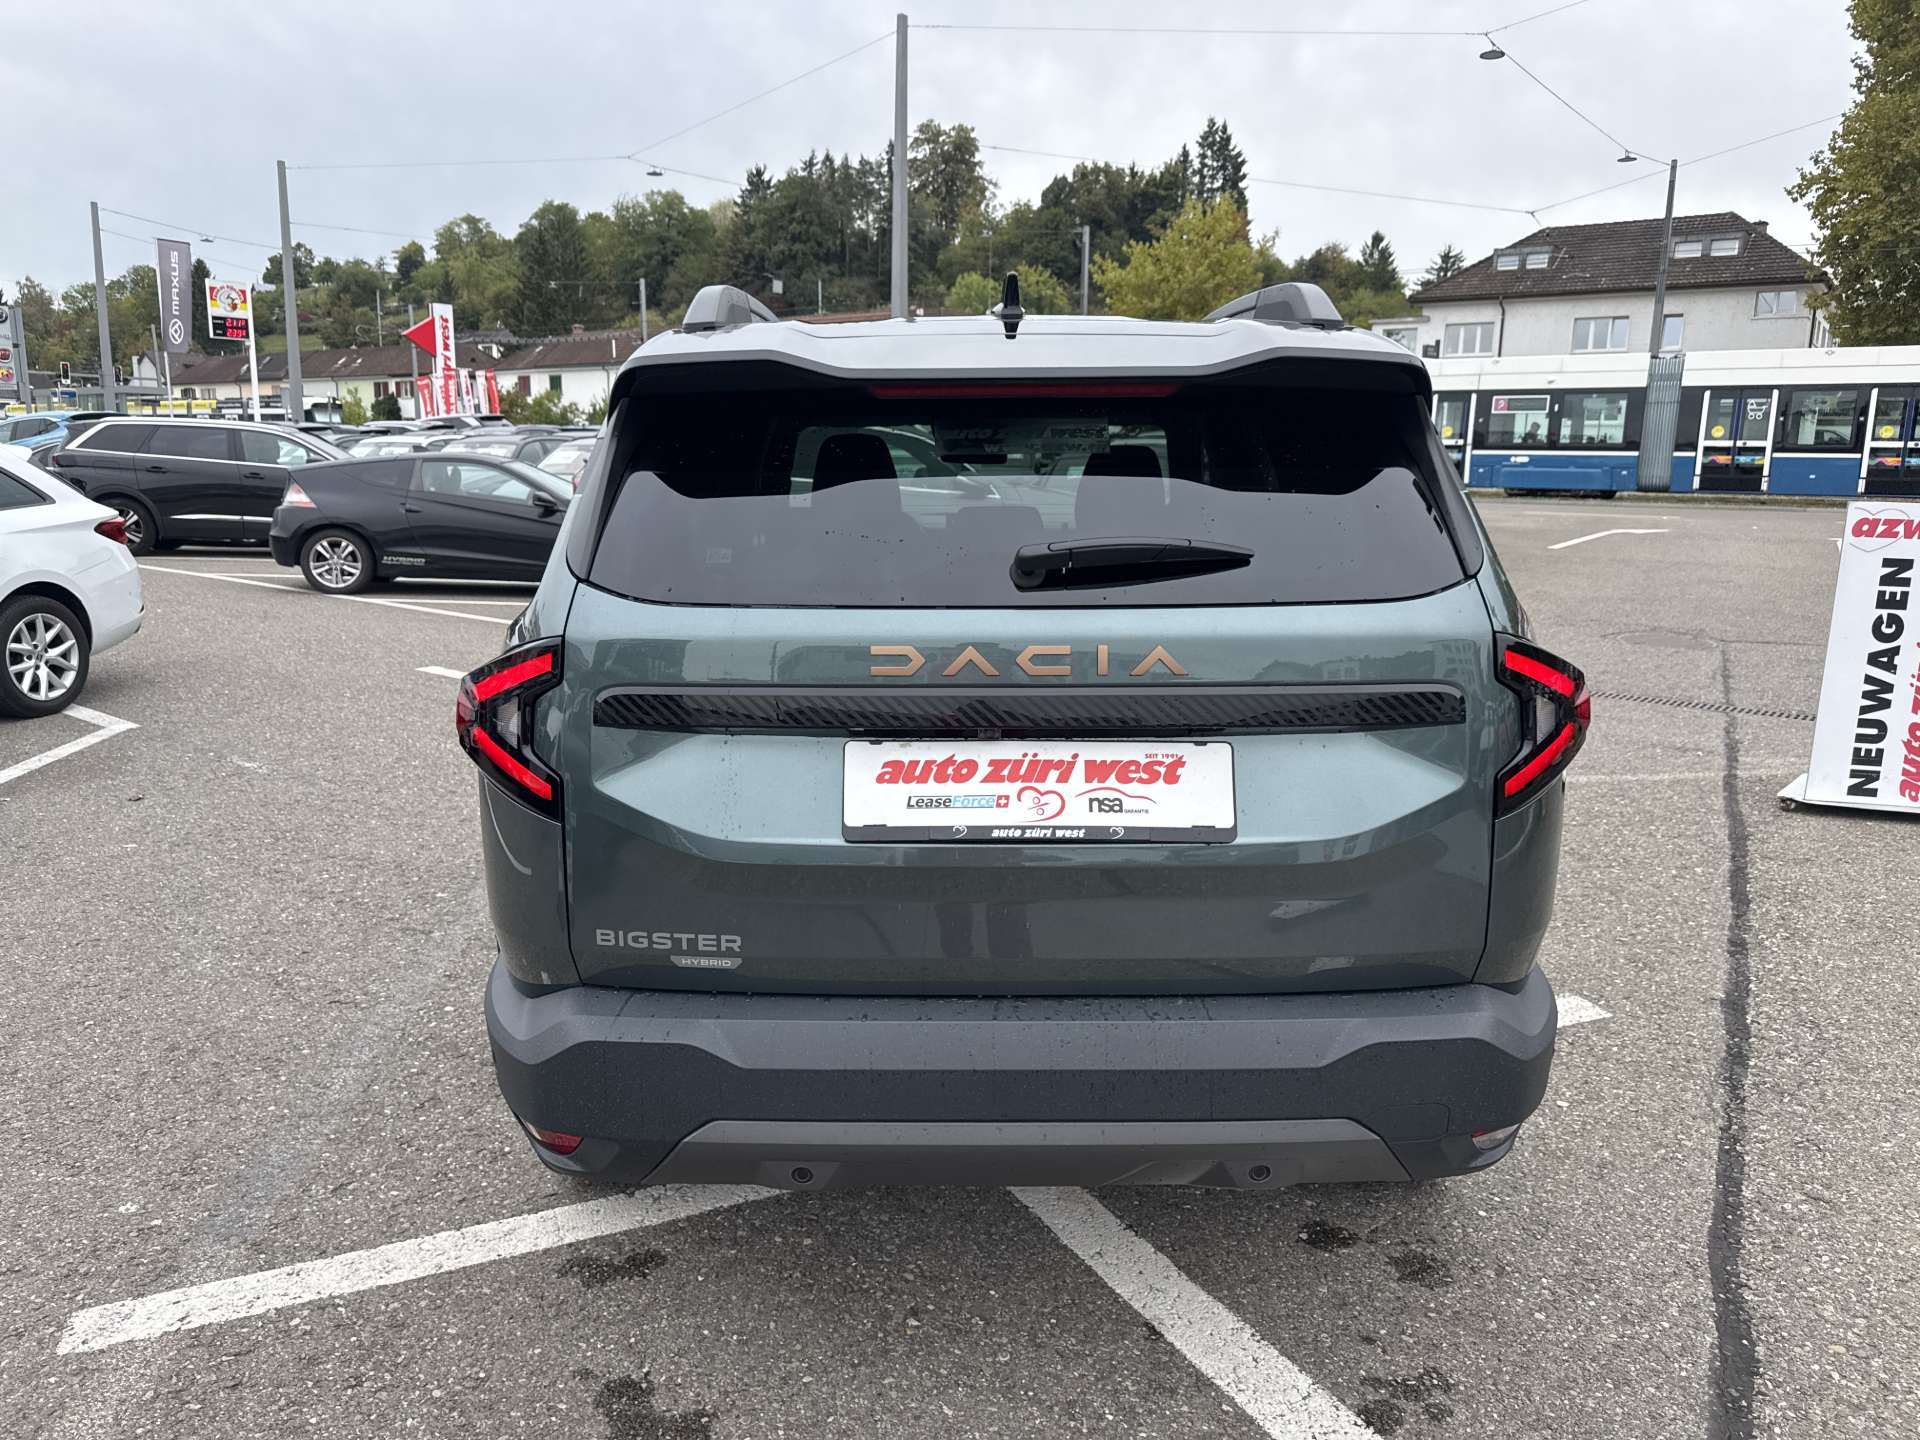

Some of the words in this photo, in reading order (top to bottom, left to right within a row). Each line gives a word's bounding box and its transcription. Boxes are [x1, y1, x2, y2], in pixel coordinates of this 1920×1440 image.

[170, 250, 179, 315] MAXUS
[870, 645, 1190, 676] DACIA
[1847, 558, 1914, 797] NEUWAGEN
[876, 753, 978, 785] auto
[979, 752, 1080, 785] züri
[1084, 755, 1187, 785] west
[907, 795, 995, 808] LeaseForce
[1088, 797, 1124, 813] nsa
[991, 827, 1021, 838] auto
[1023, 826, 1053, 838] züri
[1055, 827, 1086, 838] west
[595, 928, 742, 952] BIGSTER
[681, 957, 732, 967] HYBRID
